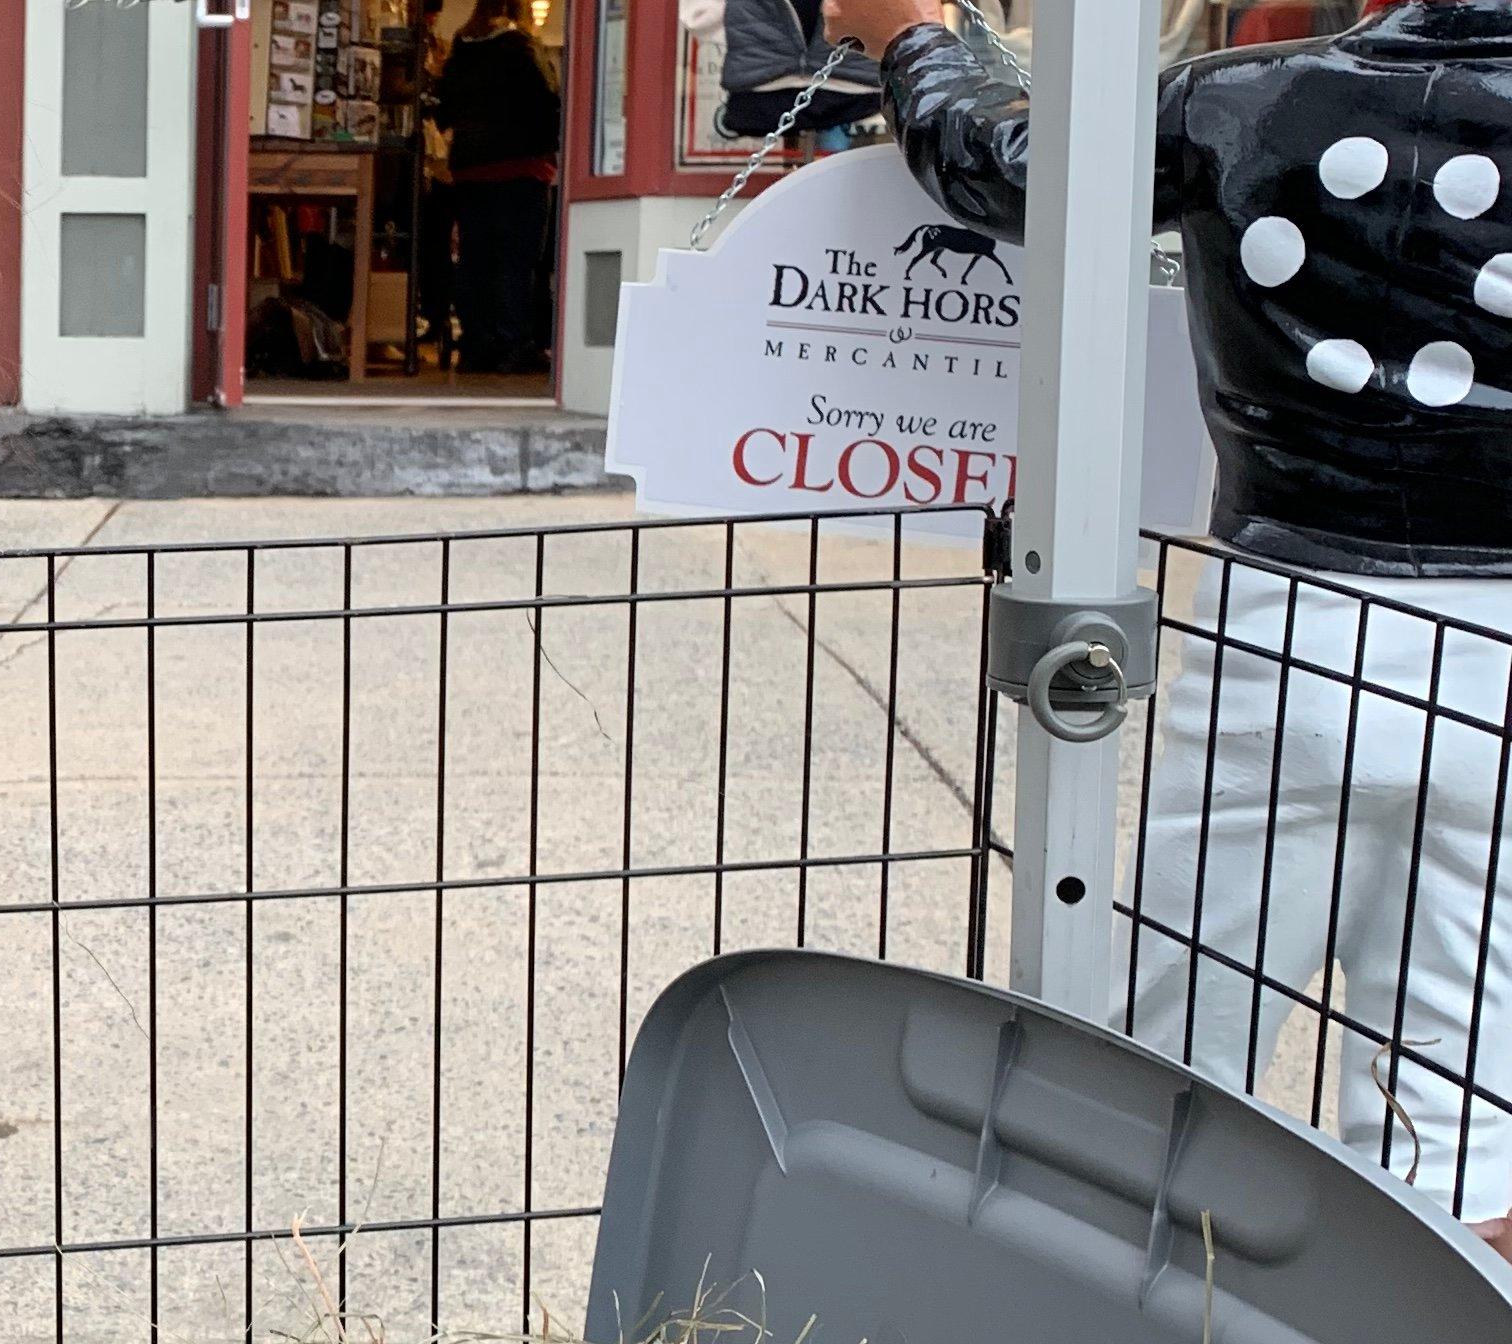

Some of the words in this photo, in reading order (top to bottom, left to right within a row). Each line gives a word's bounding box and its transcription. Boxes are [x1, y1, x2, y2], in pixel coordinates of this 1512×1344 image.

[825, 248, 878, 278] The
[768, 263, 891, 317] DARK
[900, 285, 1022, 328] HORS
[763, 339, 1008, 379] MERCANTIL
[806, 393, 885, 437] Sorry
[895, 414, 938, 437] we
[948, 419, 997, 443] are
[731, 427, 1018, 506] CLOSE
